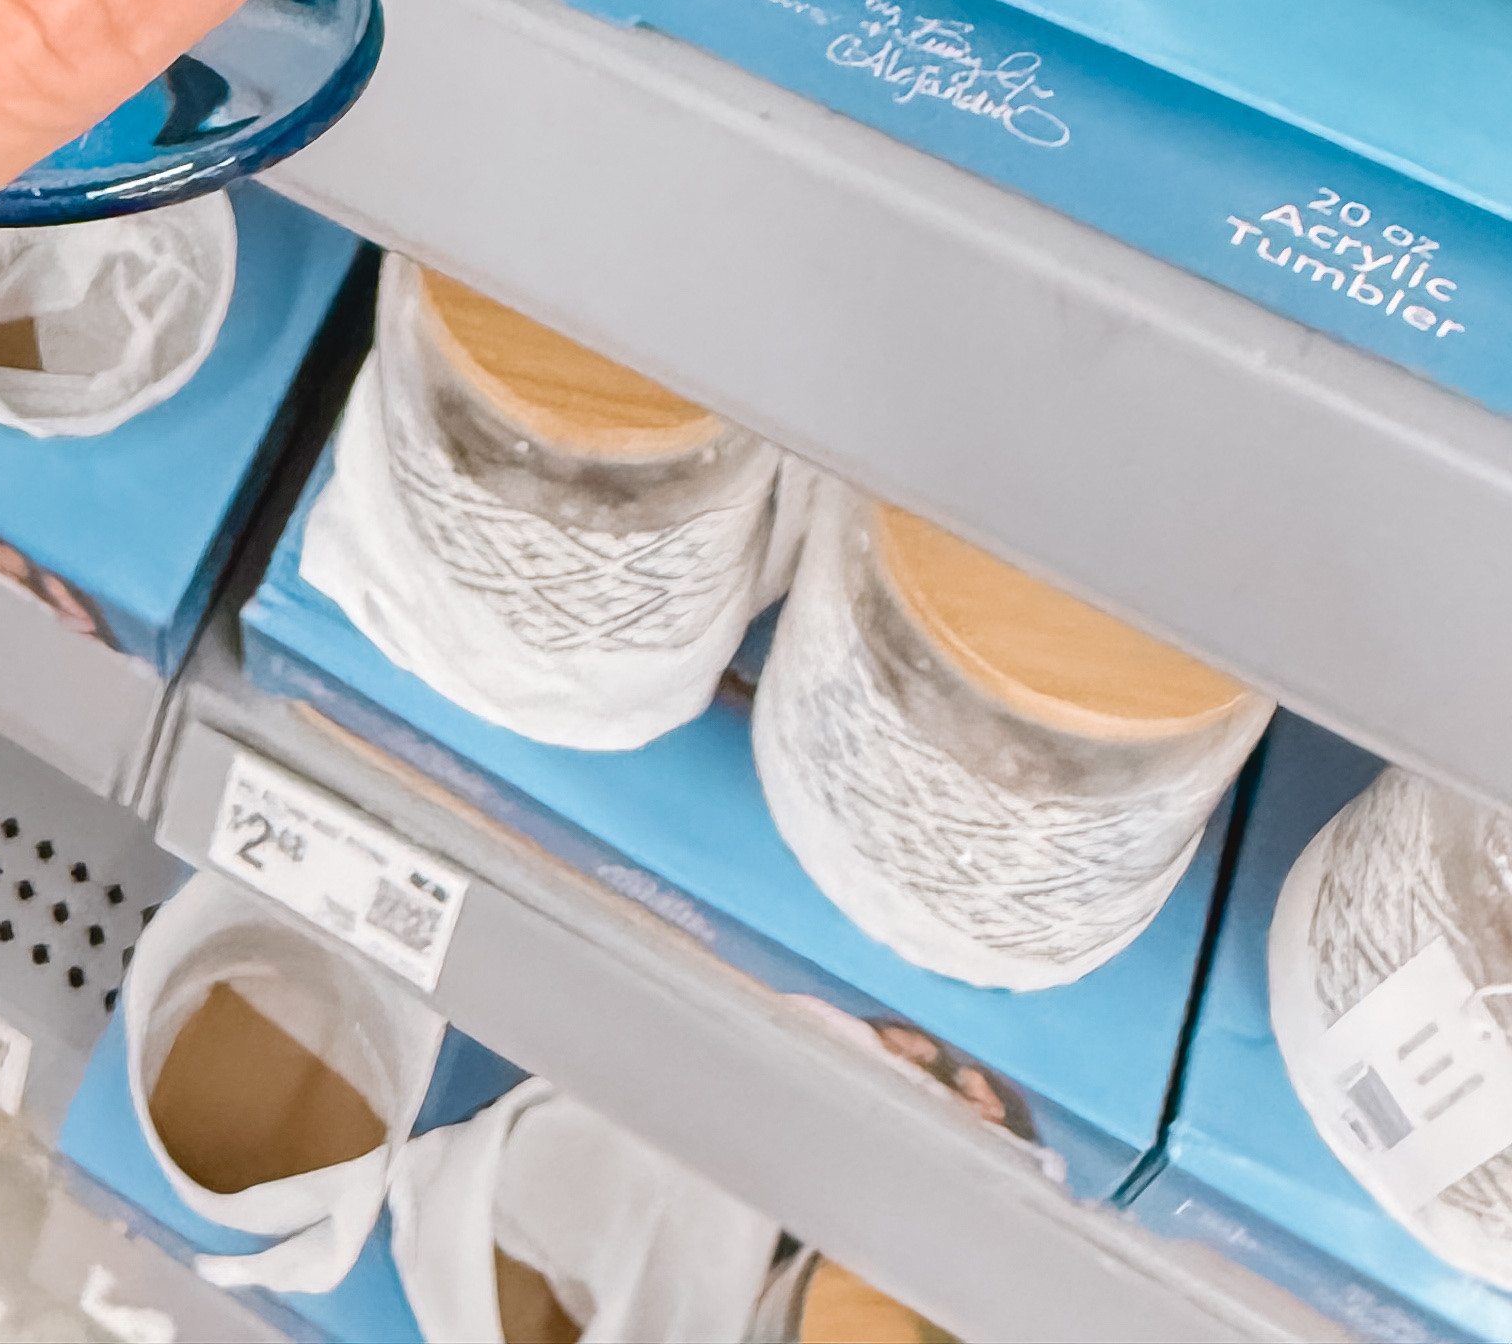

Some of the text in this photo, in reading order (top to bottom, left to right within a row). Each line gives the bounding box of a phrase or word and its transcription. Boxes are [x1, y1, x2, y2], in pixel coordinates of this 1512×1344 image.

[1260, 204, 1458, 302] Acrylic
[1307, 186, 1371, 228] 20
[1226, 215, 1466, 338] Tumbler
